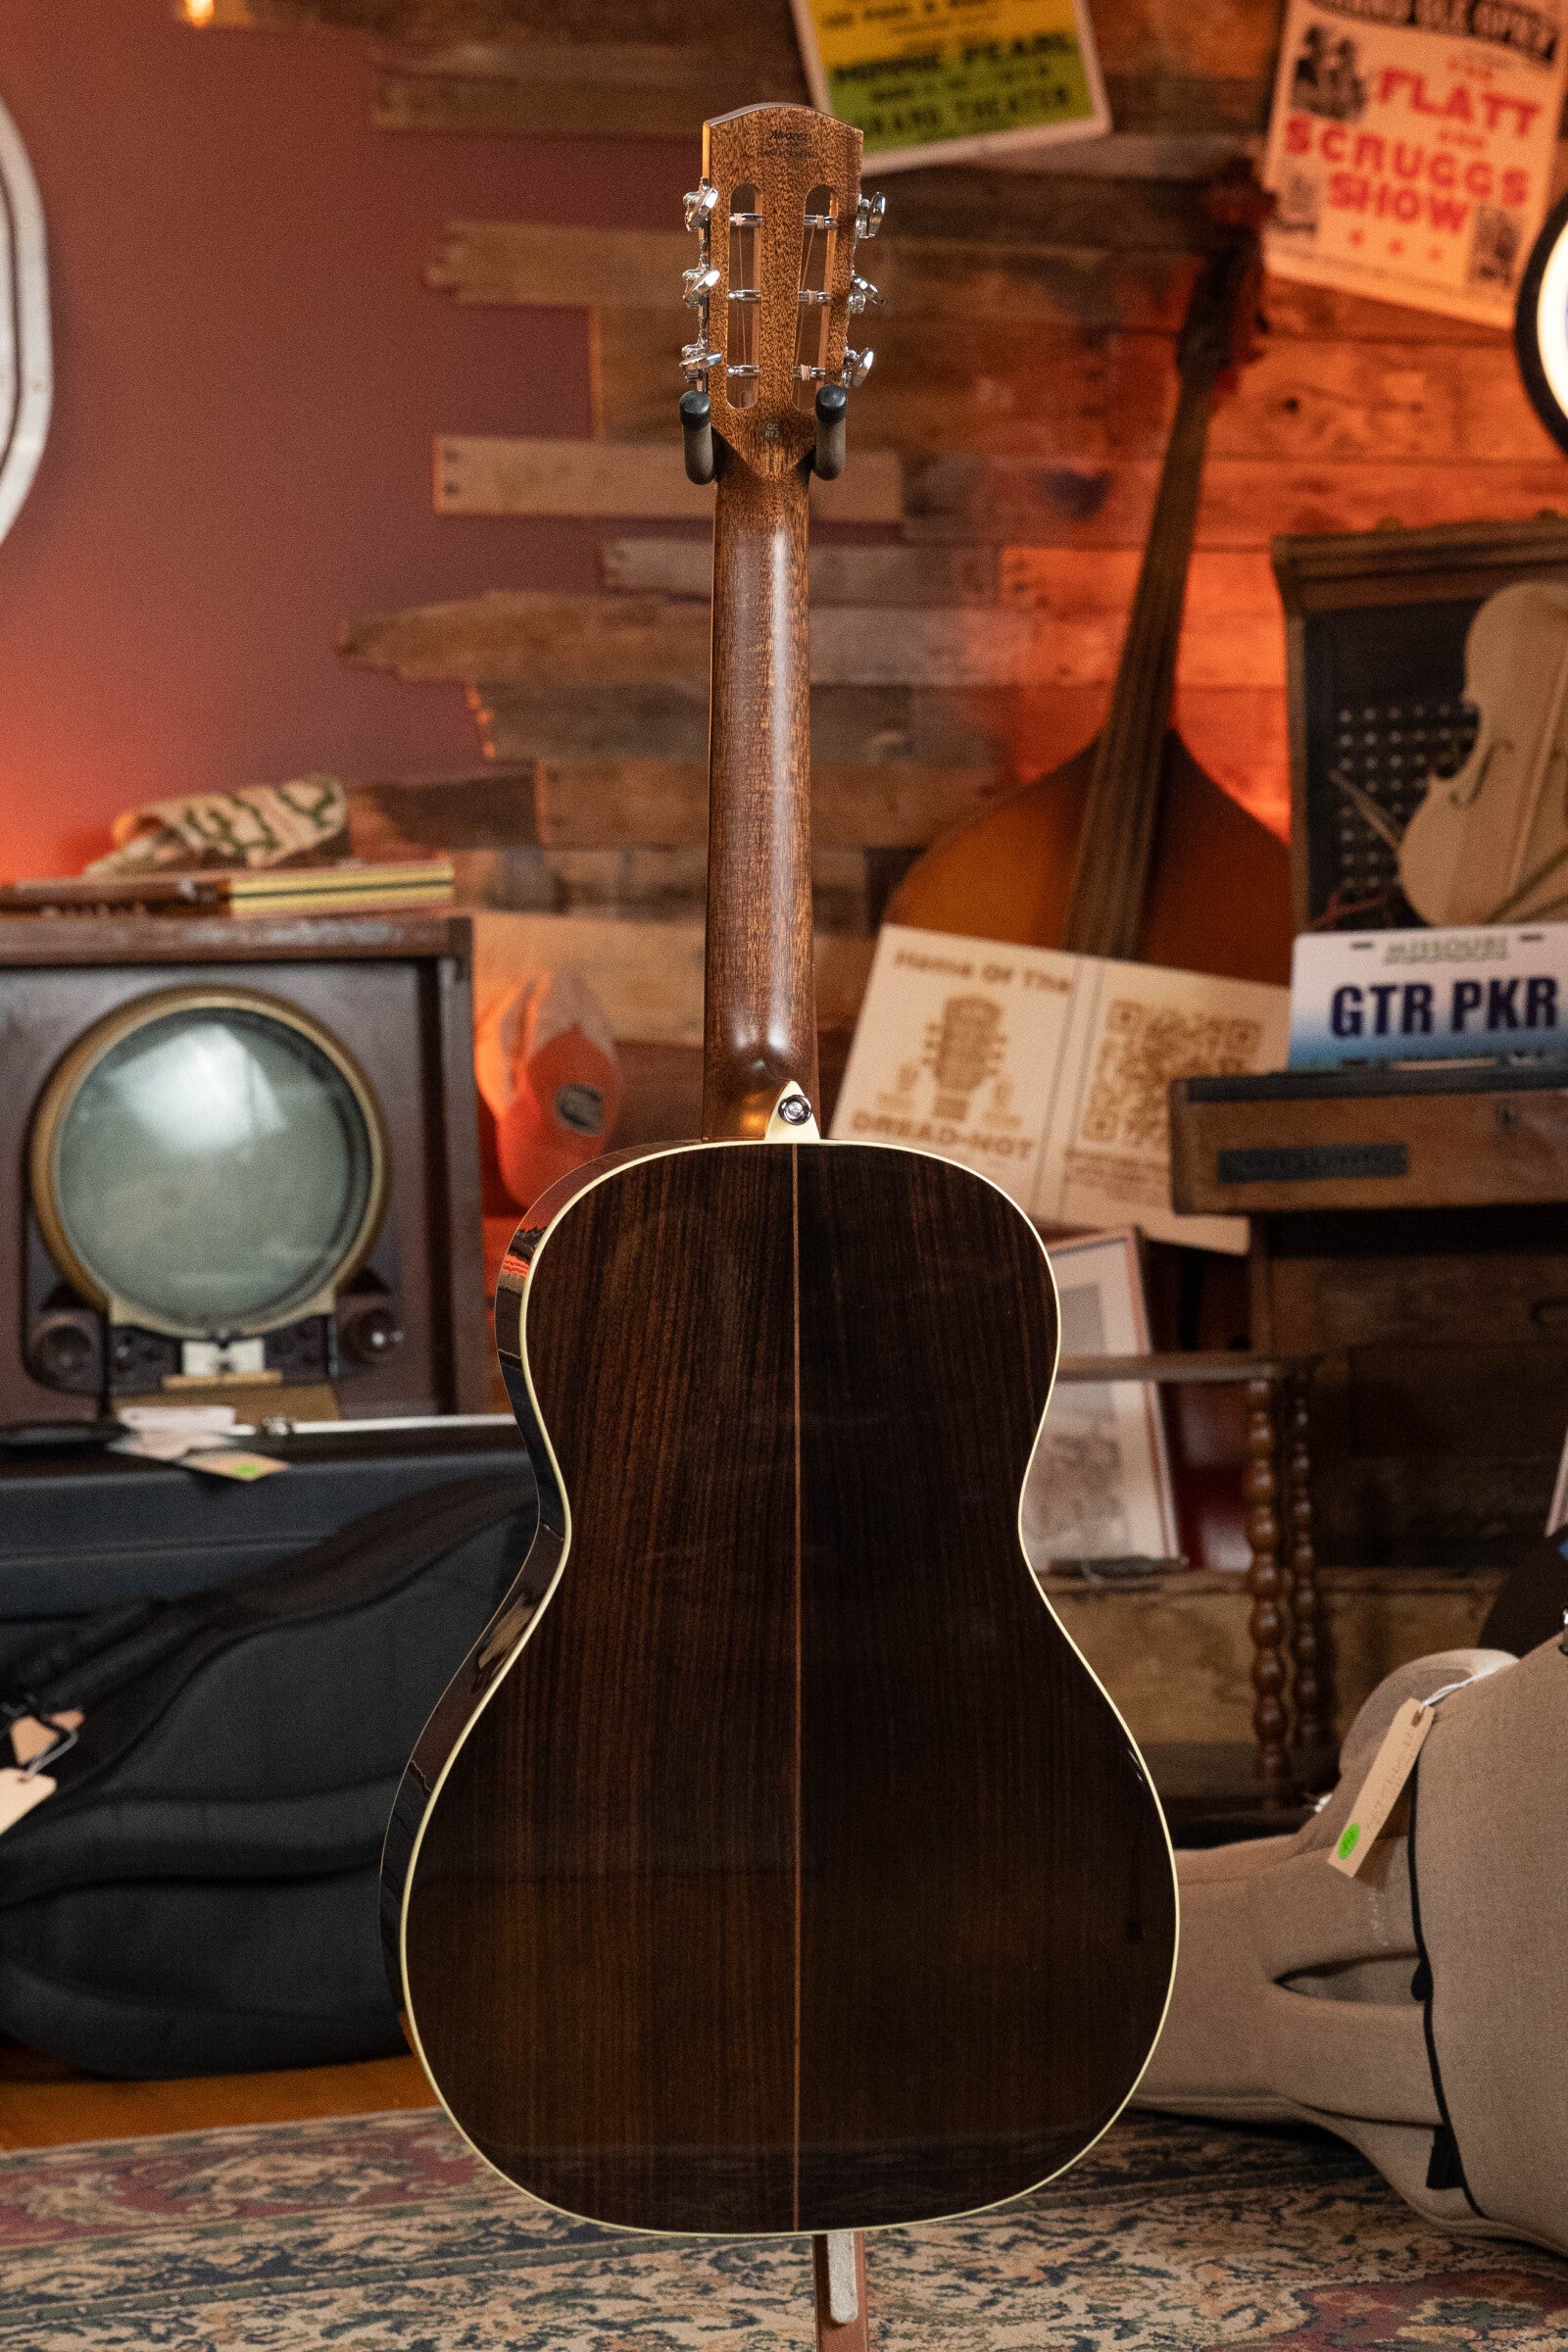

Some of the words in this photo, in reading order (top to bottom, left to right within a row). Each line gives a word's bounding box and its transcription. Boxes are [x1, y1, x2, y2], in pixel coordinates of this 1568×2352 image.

[1378, 67, 1542, 138] FLATT
[1284, 112, 1529, 209] SCRUGGS
[1327, 170, 1470, 238] SHOW
[1330, 982, 1435, 1039] GTR
[1449, 976, 1559, 1034] PKR
[850, 1107, 1035, 1160] DREAD-NOT
